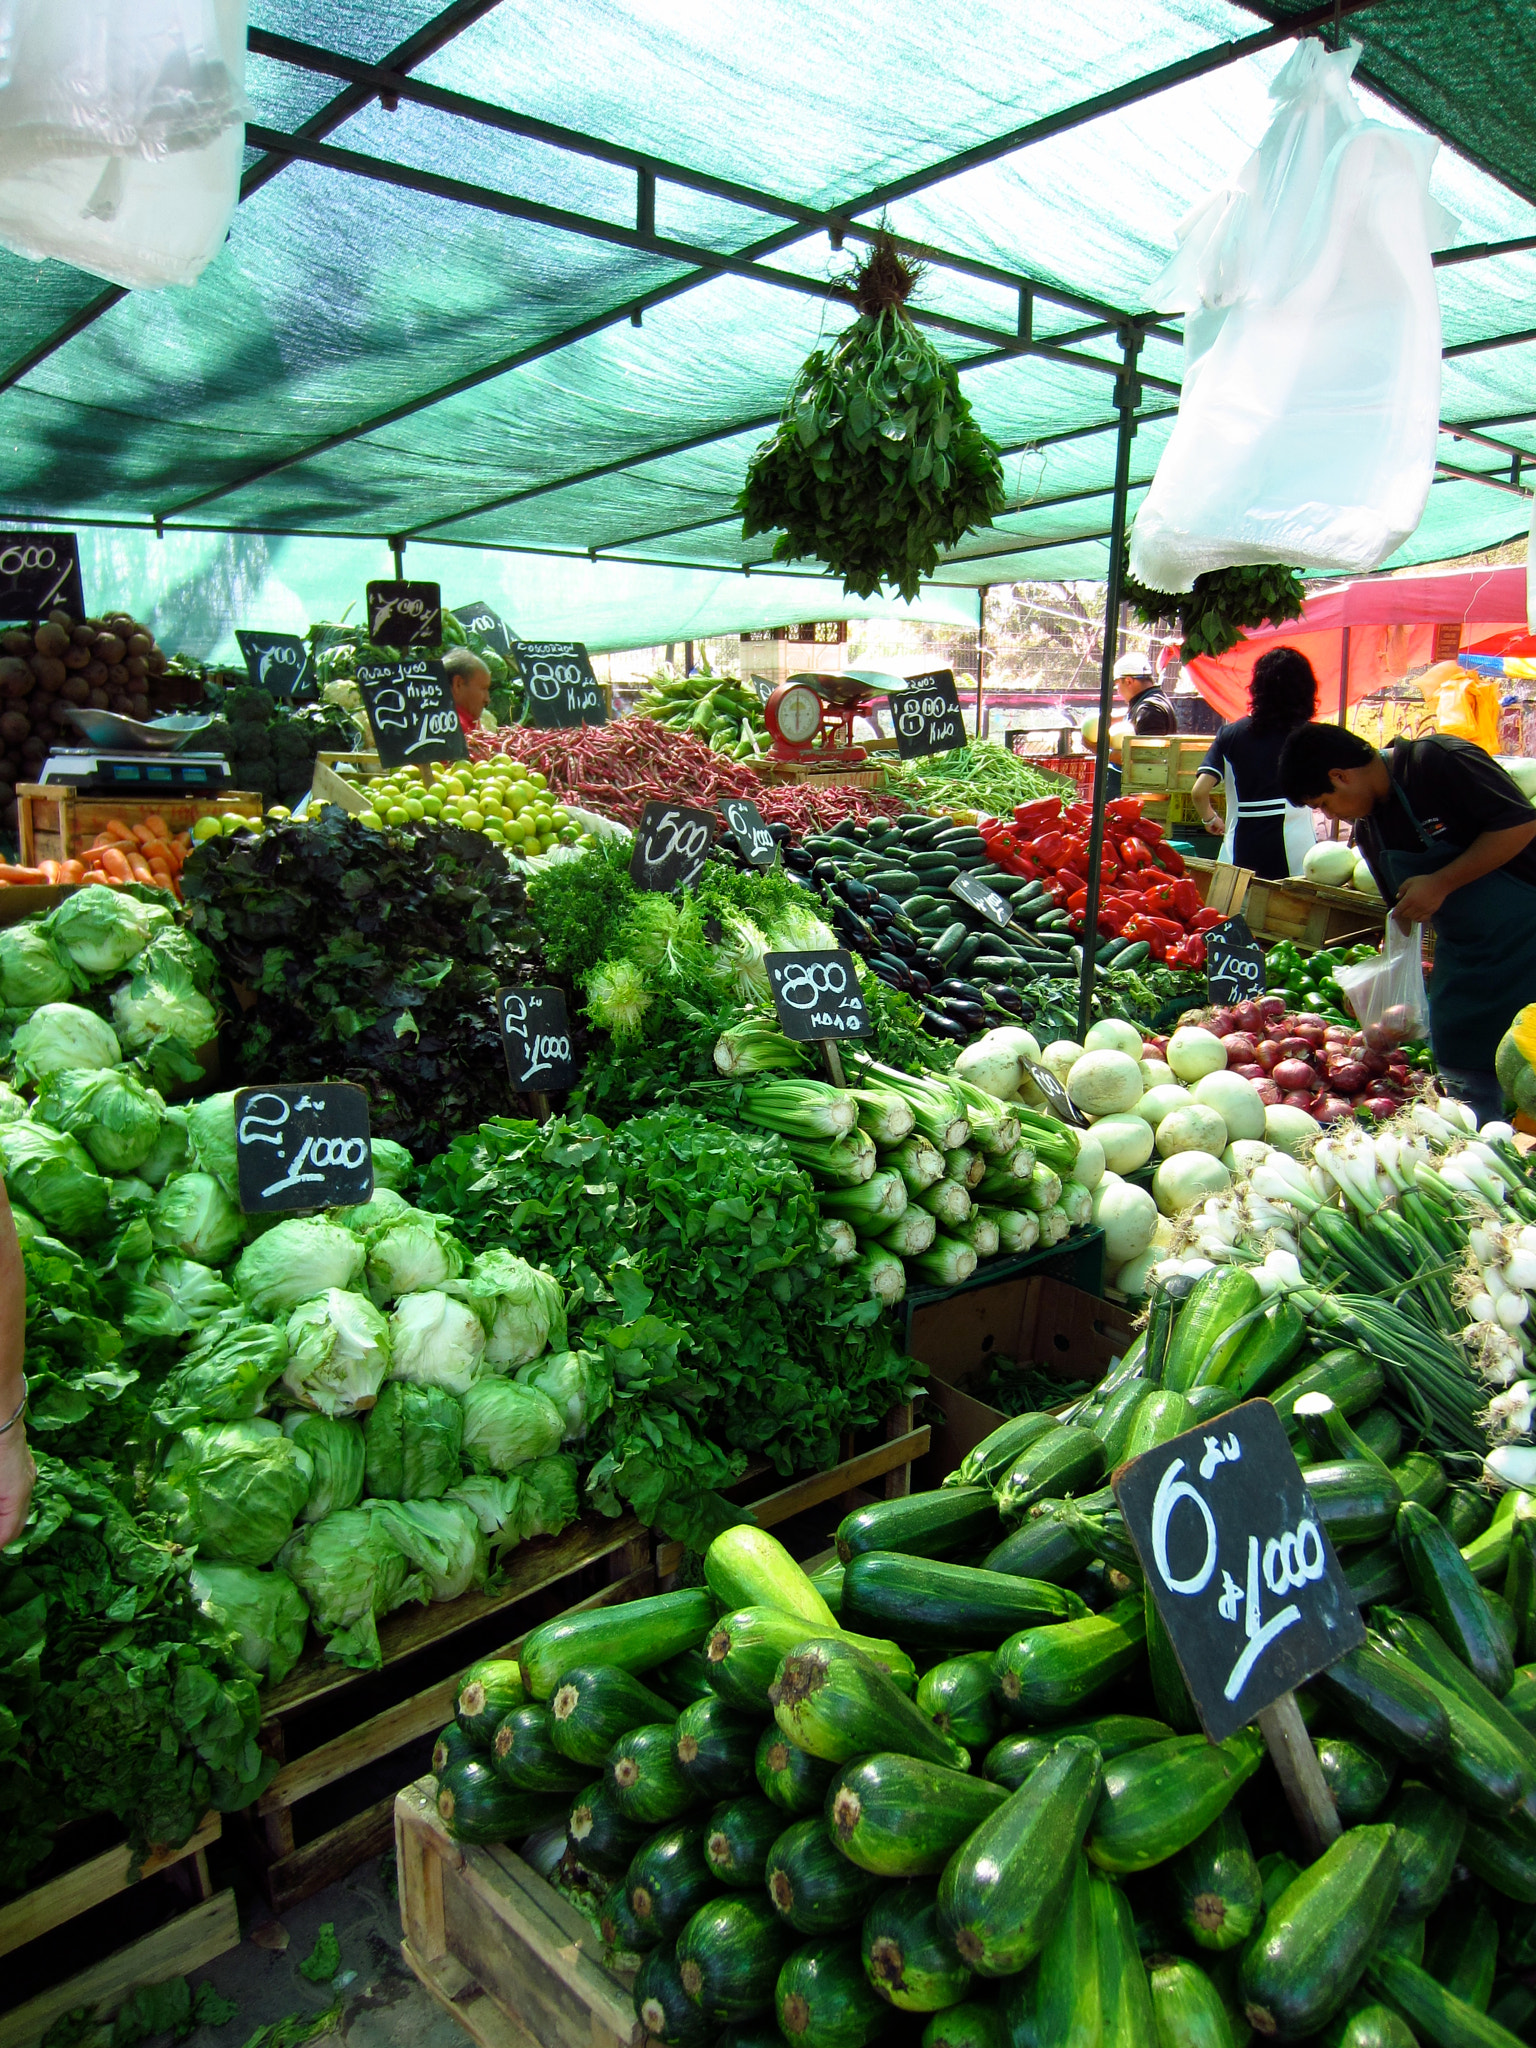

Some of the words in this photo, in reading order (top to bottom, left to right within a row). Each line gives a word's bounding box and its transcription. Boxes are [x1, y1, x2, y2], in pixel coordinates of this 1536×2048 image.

[0, 546, 56, 575] 600
[373, 689, 407, 730] 2
[728, 804, 747, 835] 6
[504, 995, 528, 1038] 2
[239, 1093, 290, 1145] 2
[1152, 1458, 1217, 1594] 6
